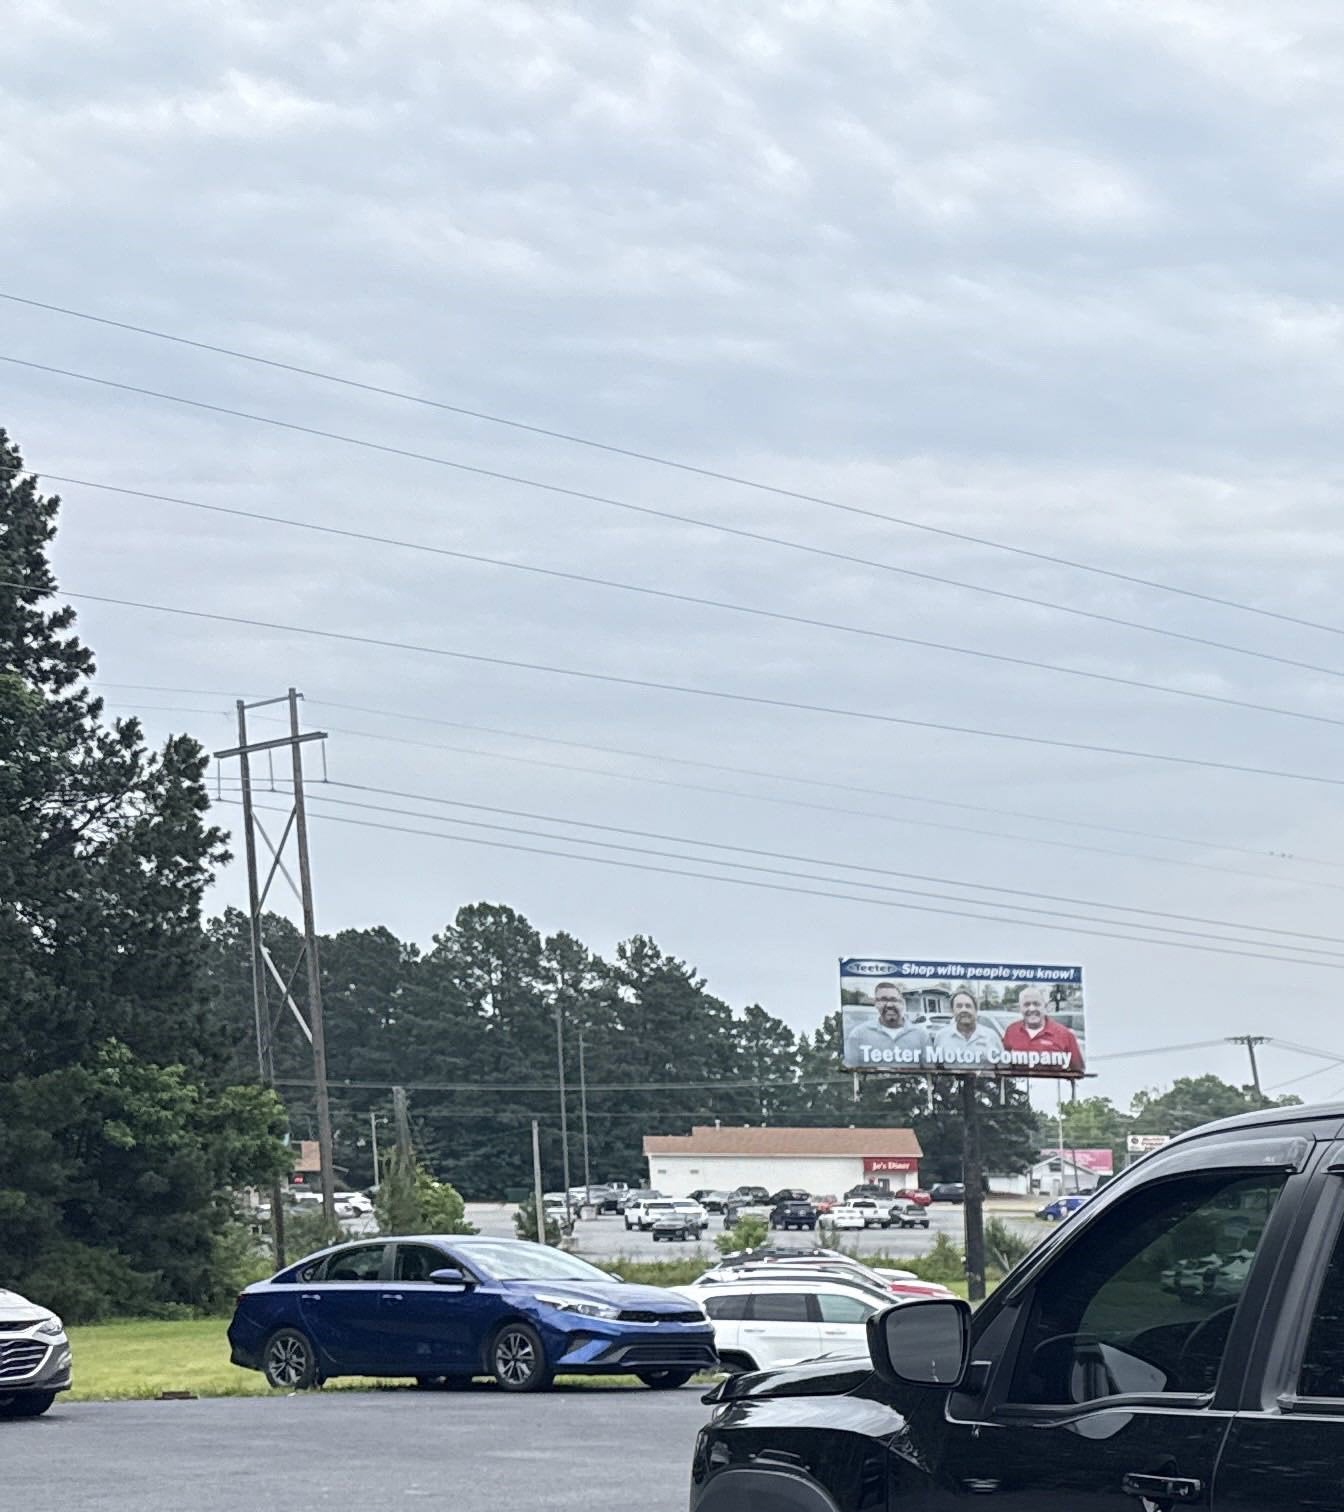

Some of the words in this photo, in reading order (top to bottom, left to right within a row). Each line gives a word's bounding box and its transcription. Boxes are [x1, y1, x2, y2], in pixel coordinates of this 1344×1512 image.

[853, 962, 893, 973] Teeter
[901, 963, 934, 978] Shop
[936, 964, 965, 976] with
[967, 965, 1010, 980] people
[1012, 968, 1035, 980] you
[1037, 966, 1074, 980] know!
[859, 1045, 921, 1063] Teeter
[925, 1046, 982, 1064] Motor
[987, 1048, 1073, 1070] Company
